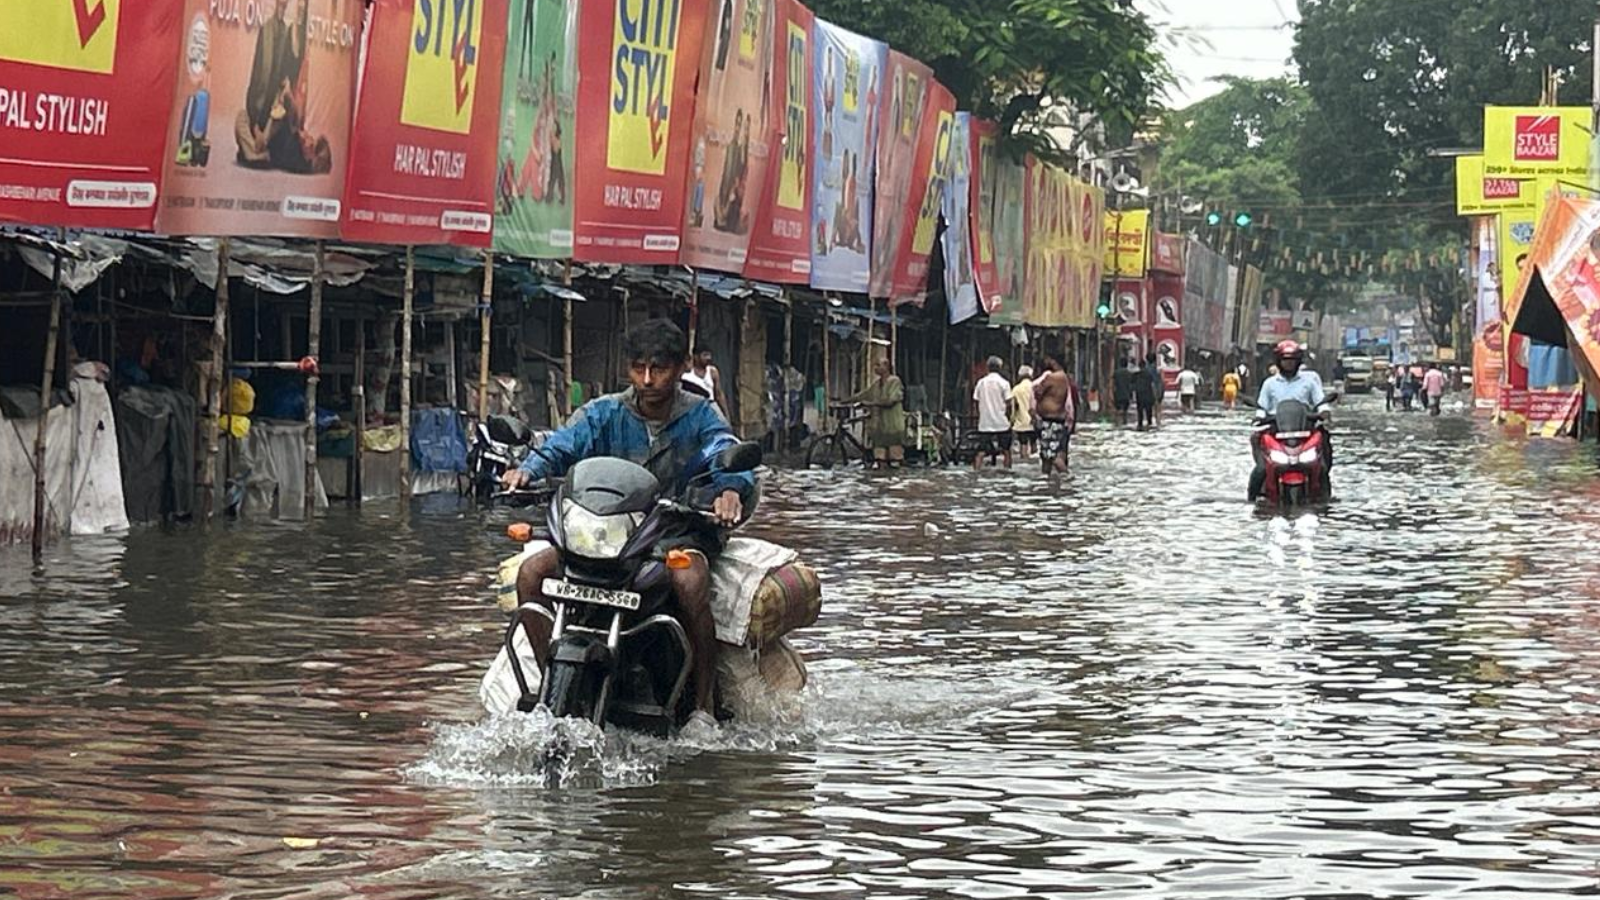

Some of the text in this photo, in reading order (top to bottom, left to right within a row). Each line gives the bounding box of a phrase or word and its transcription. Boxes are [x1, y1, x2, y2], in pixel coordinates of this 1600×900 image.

[308, 15, 339, 46] STYLE
[34, 93, 109, 136] STYLISH
[1516, 146, 1557, 156] BAAZAR
[1517, 133, 1558, 146] STYLE
[394, 144, 467, 179] HAR PAL STYLISH
